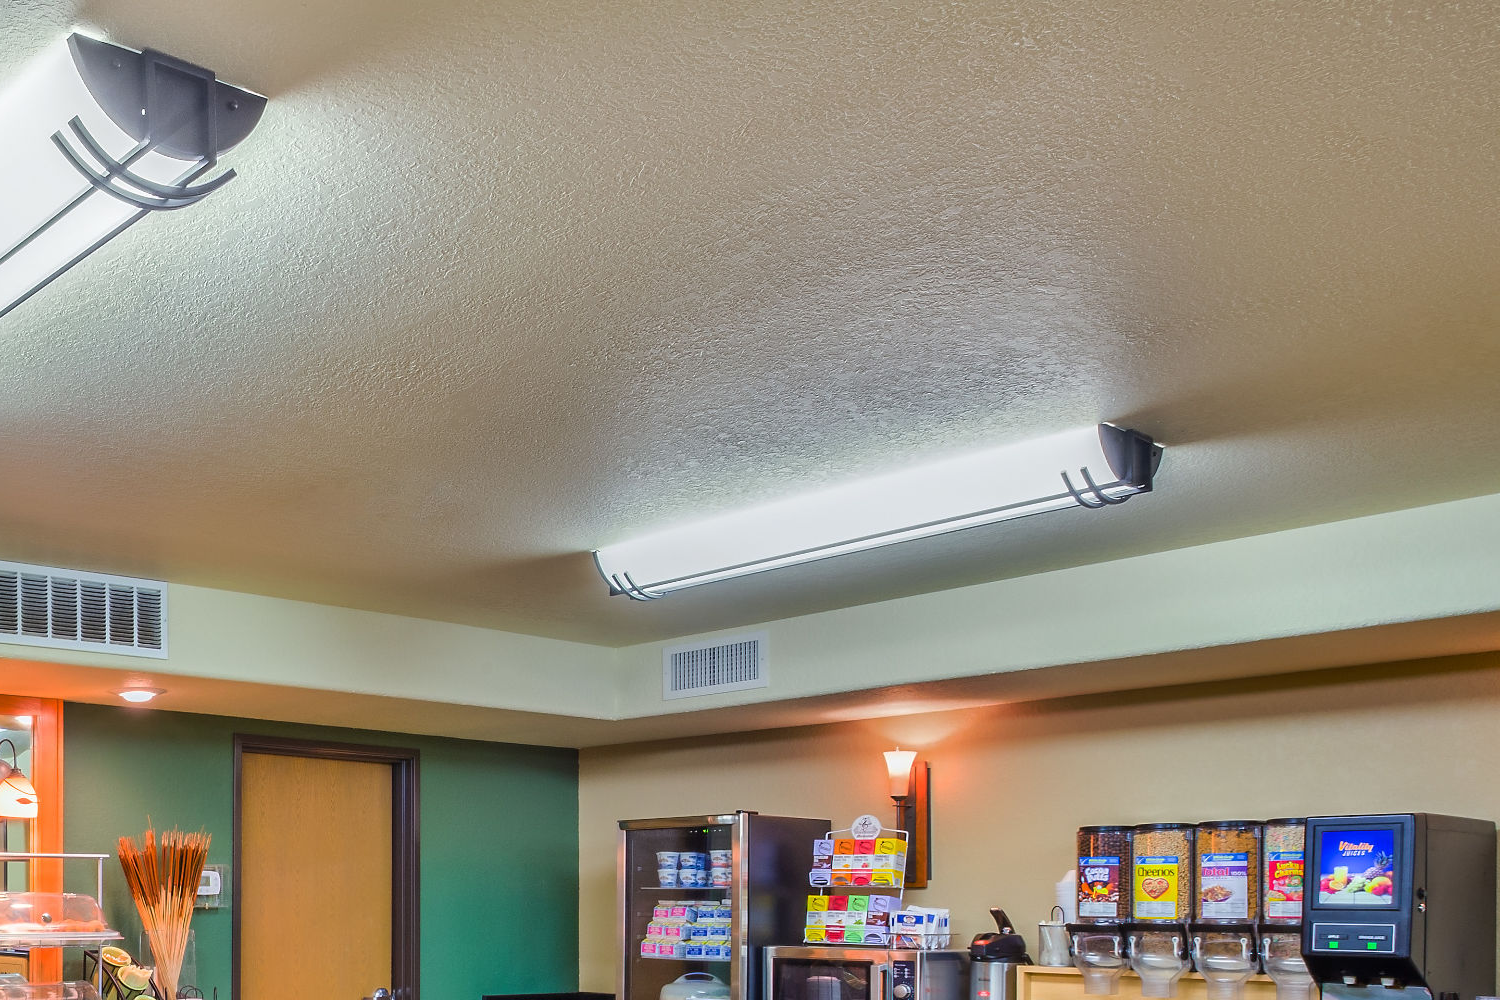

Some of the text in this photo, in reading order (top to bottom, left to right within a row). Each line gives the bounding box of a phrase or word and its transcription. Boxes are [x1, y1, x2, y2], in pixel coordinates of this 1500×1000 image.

[1338, 840, 1375, 852] Vitality
[1137, 866, 1175, 877] Cheerios
[1203, 867, 1229, 877] Total
